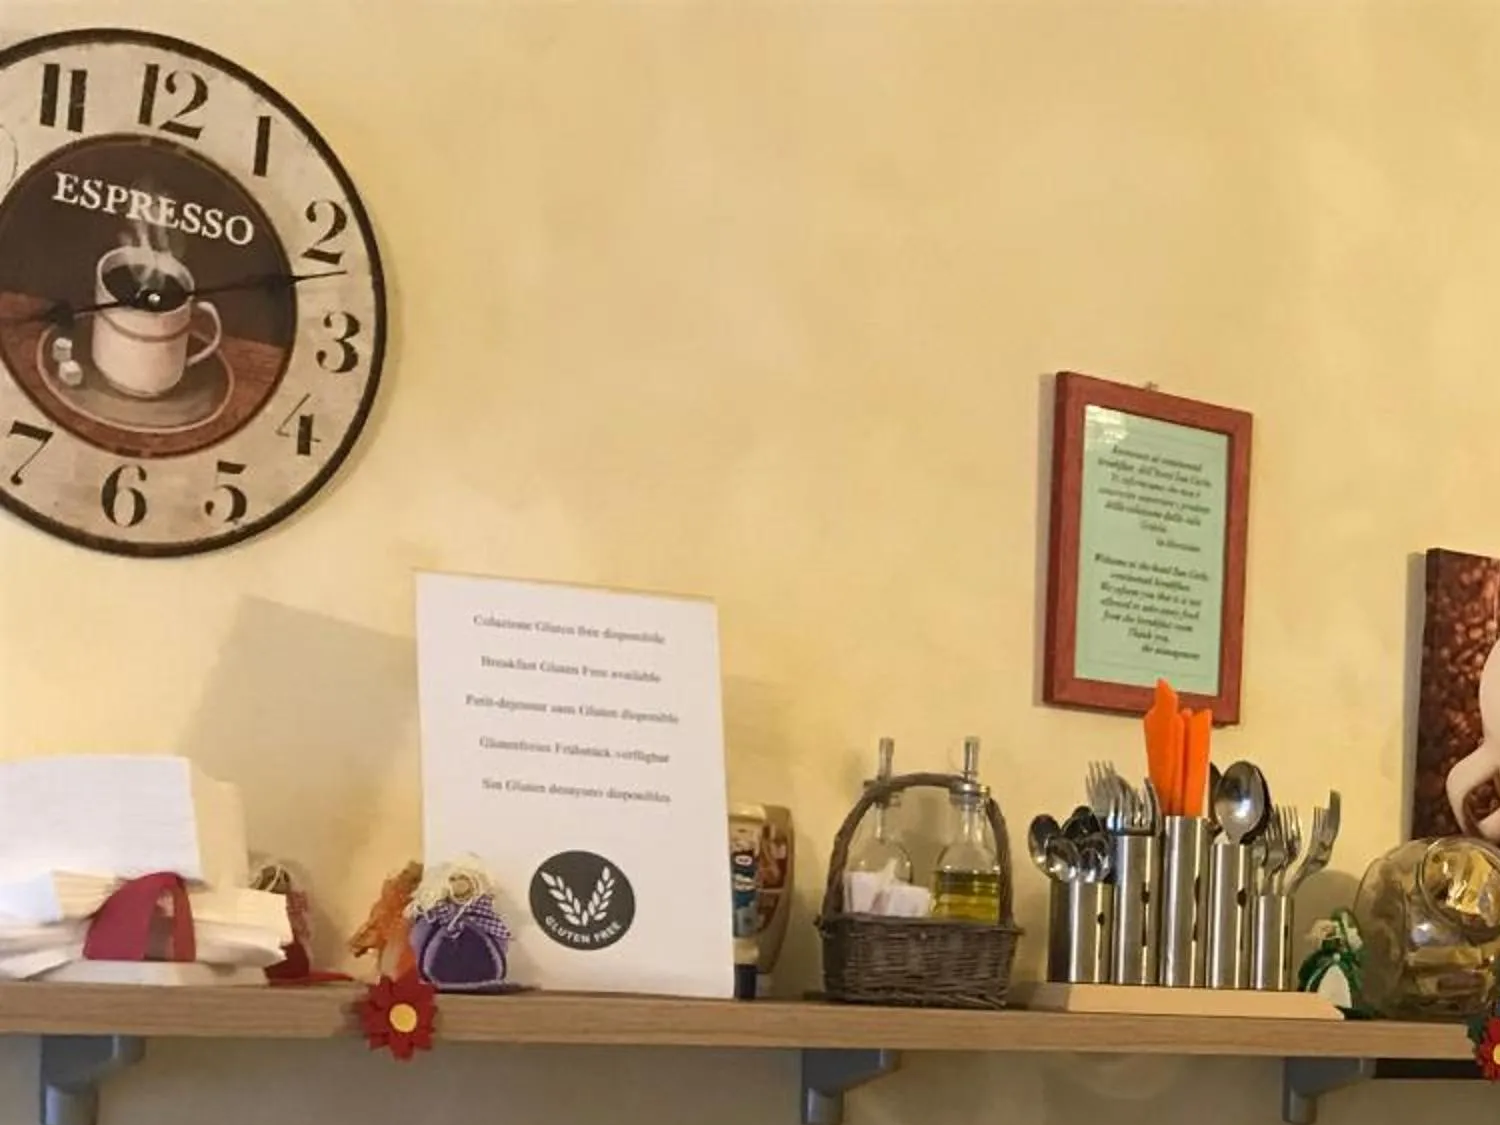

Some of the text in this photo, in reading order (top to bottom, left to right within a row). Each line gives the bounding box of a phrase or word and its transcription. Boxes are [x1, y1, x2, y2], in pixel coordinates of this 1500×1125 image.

[40, 63, 87, 133] 11
[138, 63, 209, 139] 12
[253, 115, 271, 177] 1
[52, 171, 255, 245] ESPRESSO
[301, 200, 347, 265] 2
[316, 311, 361, 374] 3
[9, 421, 53, 486] 7
[276, 393, 321, 456] 4
[101, 464, 148, 528] 6
[204, 460, 247, 522] 5
[481, 656, 537, 672] Breakfast
[545, 916, 622, 944] GLUTEN FREE
